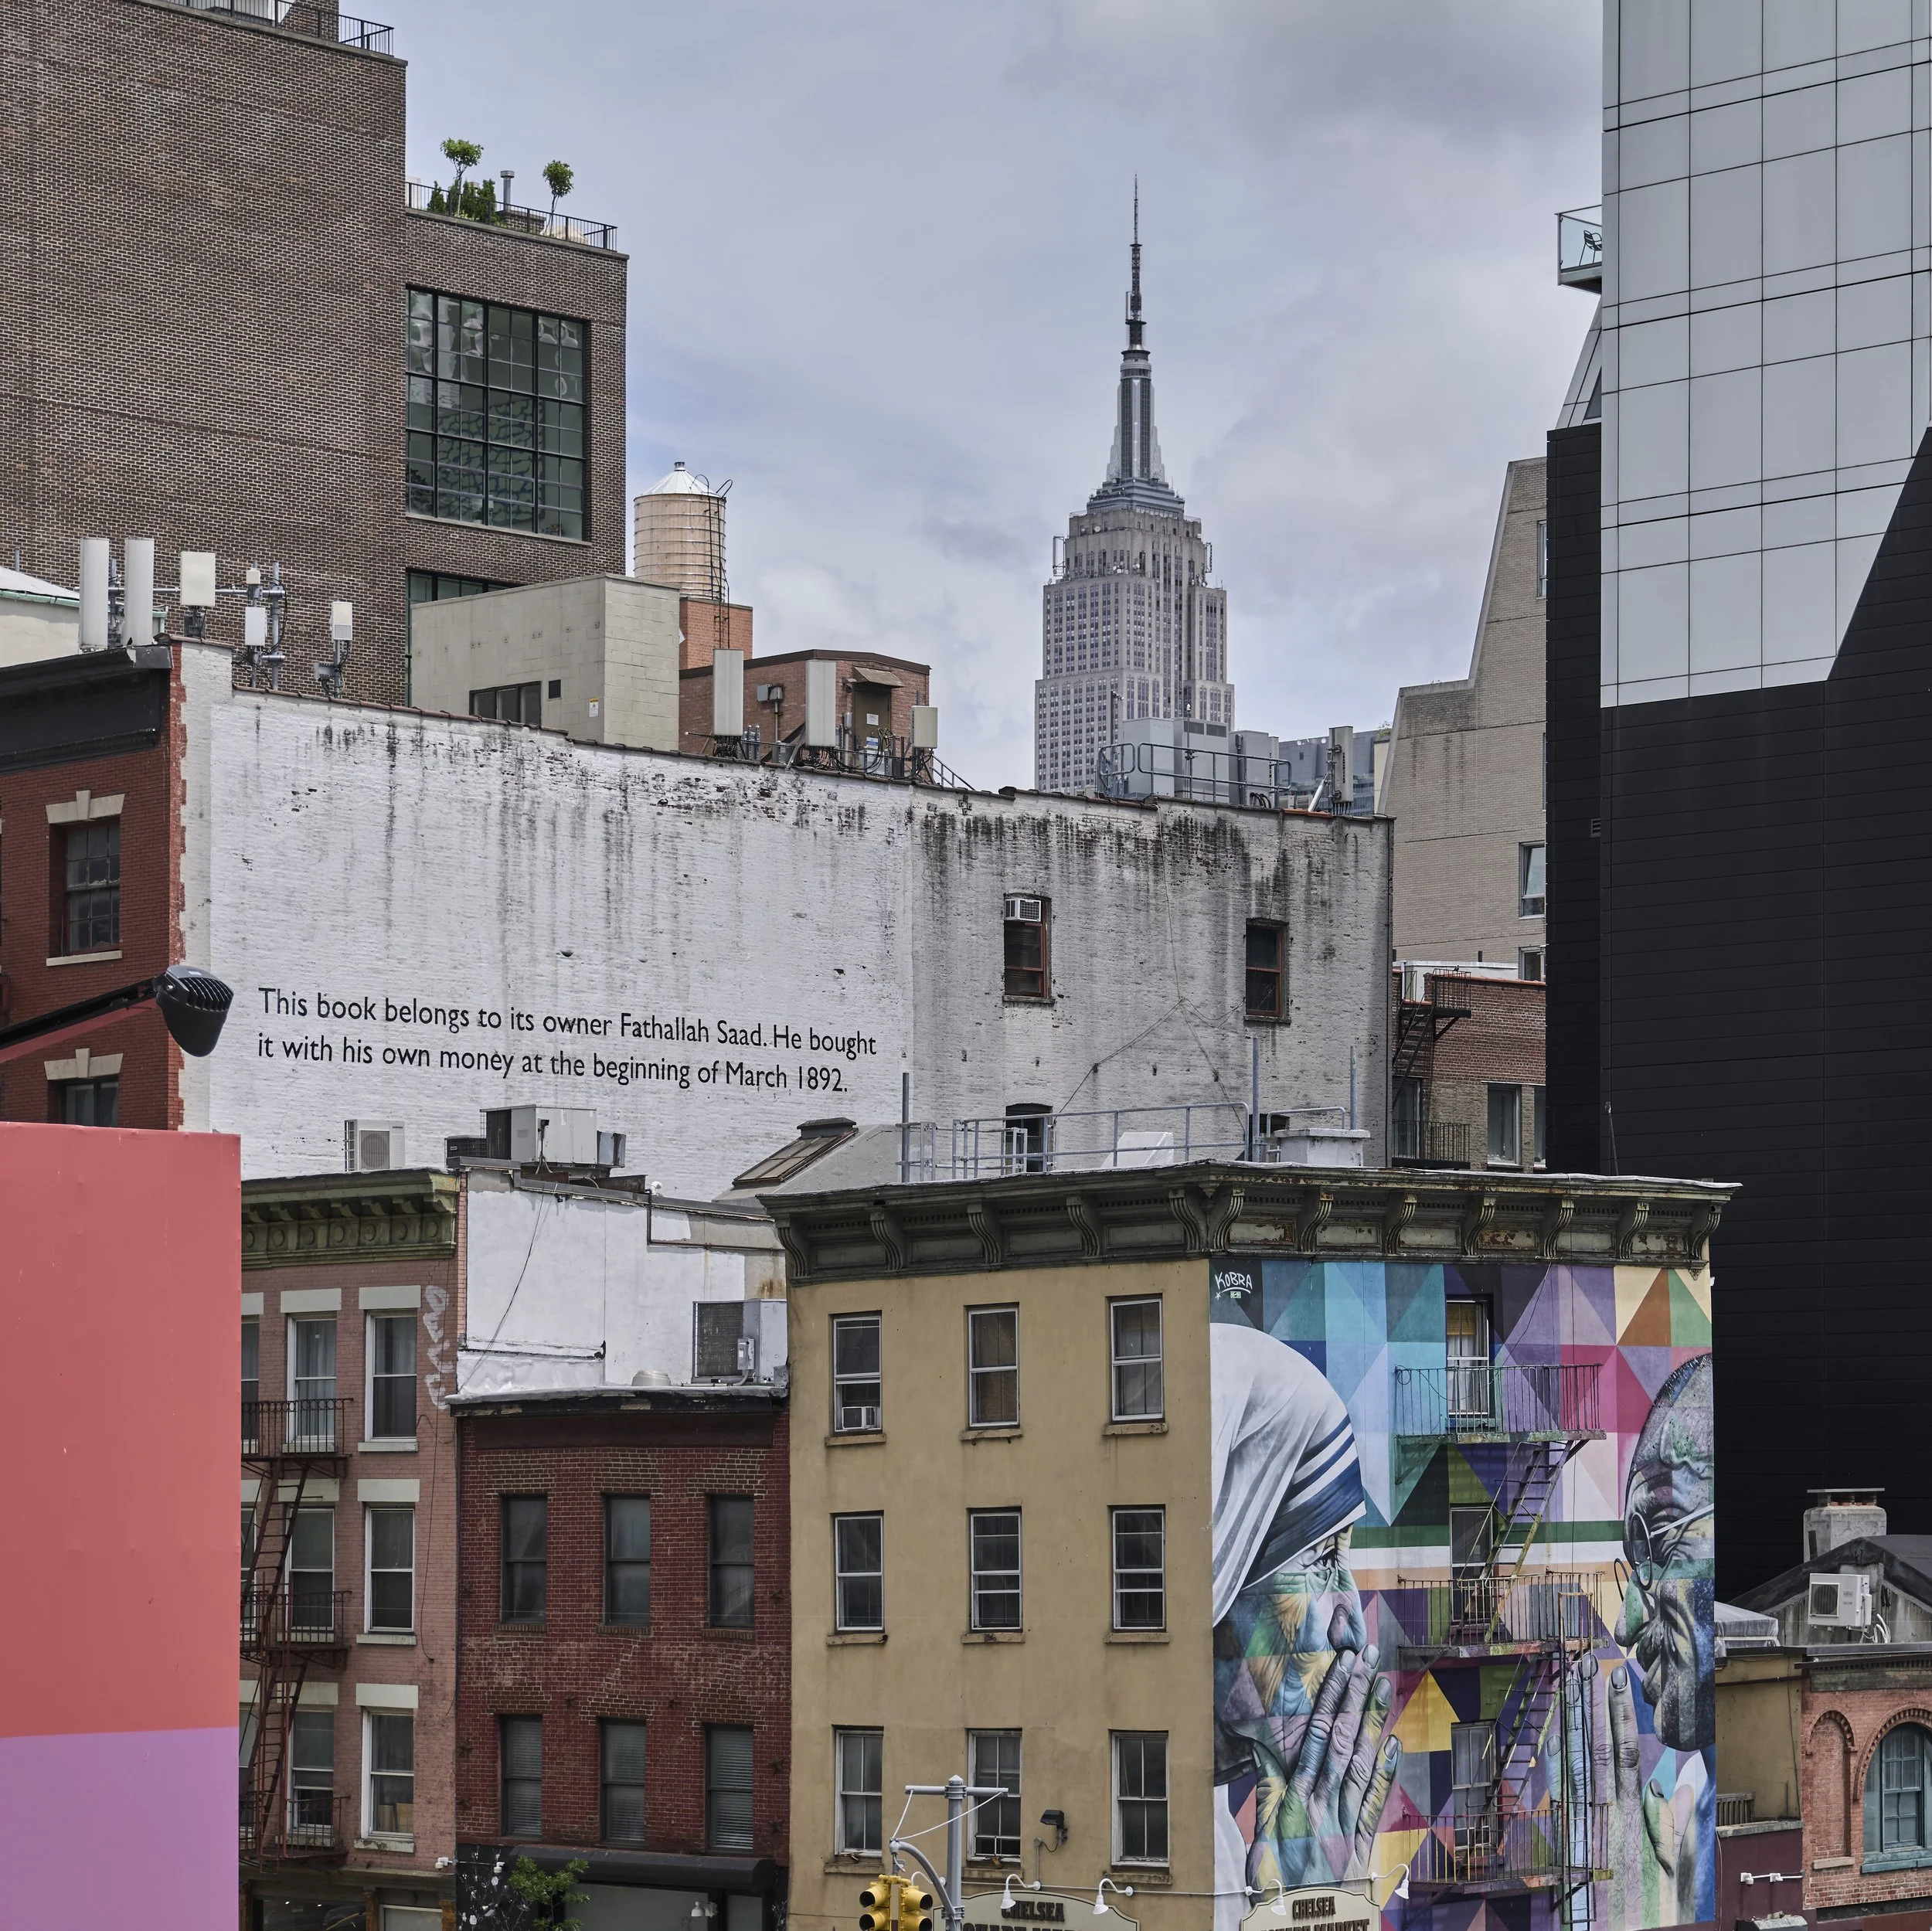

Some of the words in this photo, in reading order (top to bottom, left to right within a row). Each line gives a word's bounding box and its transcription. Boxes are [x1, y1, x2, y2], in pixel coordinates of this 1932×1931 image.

[259, 988, 307, 1016] This
[318, 993, 376, 1020] book
[386, 998, 469, 1033] belongs
[478, 1009, 501, 1028] to
[512, 1007, 534, 1031] its
[543, 1016, 612, 1035] owner
[621, 1013, 709, 1042] Fathallah
[718, 1020, 767, 1046] Saad.
[774, 1025, 801, 1049] He
[810, 1028, 876, 1060] bought
[259, 1033, 274, 1057] it
[283, 1035, 332, 1061] with
[344, 1037, 372, 1063] his
[383, 1048, 429, 1066] own
[440, 1051, 514, 1079] money
[522, 1054, 543, 1073] at
[550, 1051, 584, 1076] the
[594, 1053, 690, 1089] beginning
[698, 1061, 719, 1083] of
[726, 1061, 786, 1088] March
[799, 1066, 847, 1092] 1892.
[1215, 1272, 1252, 1289] KOBRA
[1002, 1901, 1065, 1922] CHELSEA
[1293, 1896, 1336, 1919] CHELSEA
